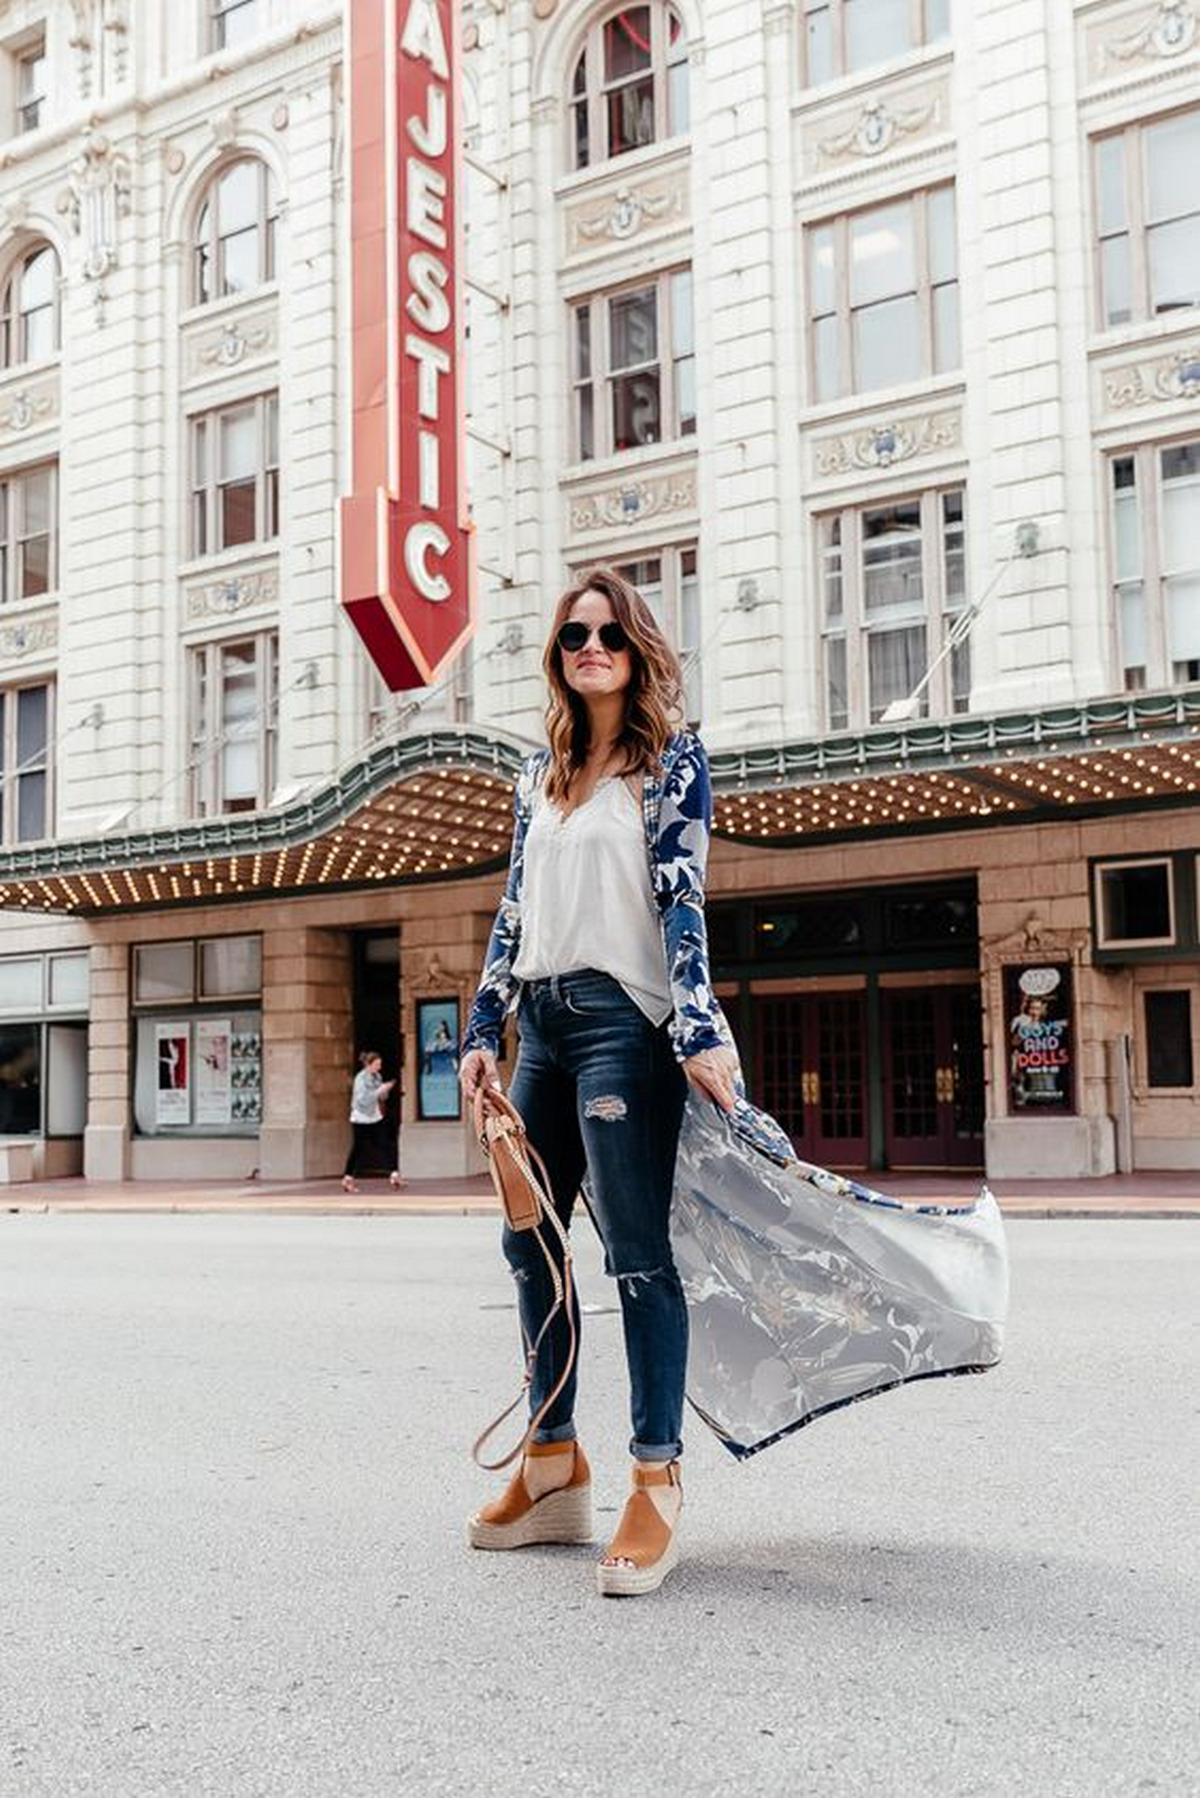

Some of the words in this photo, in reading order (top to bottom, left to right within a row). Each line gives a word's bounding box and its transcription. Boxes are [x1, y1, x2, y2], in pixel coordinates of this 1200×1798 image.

[401, 0, 450, 602] AJESTIC
[1024, 1036, 1059, 1052] AND
[1018, 1049, 1069, 1067] DOLLS
